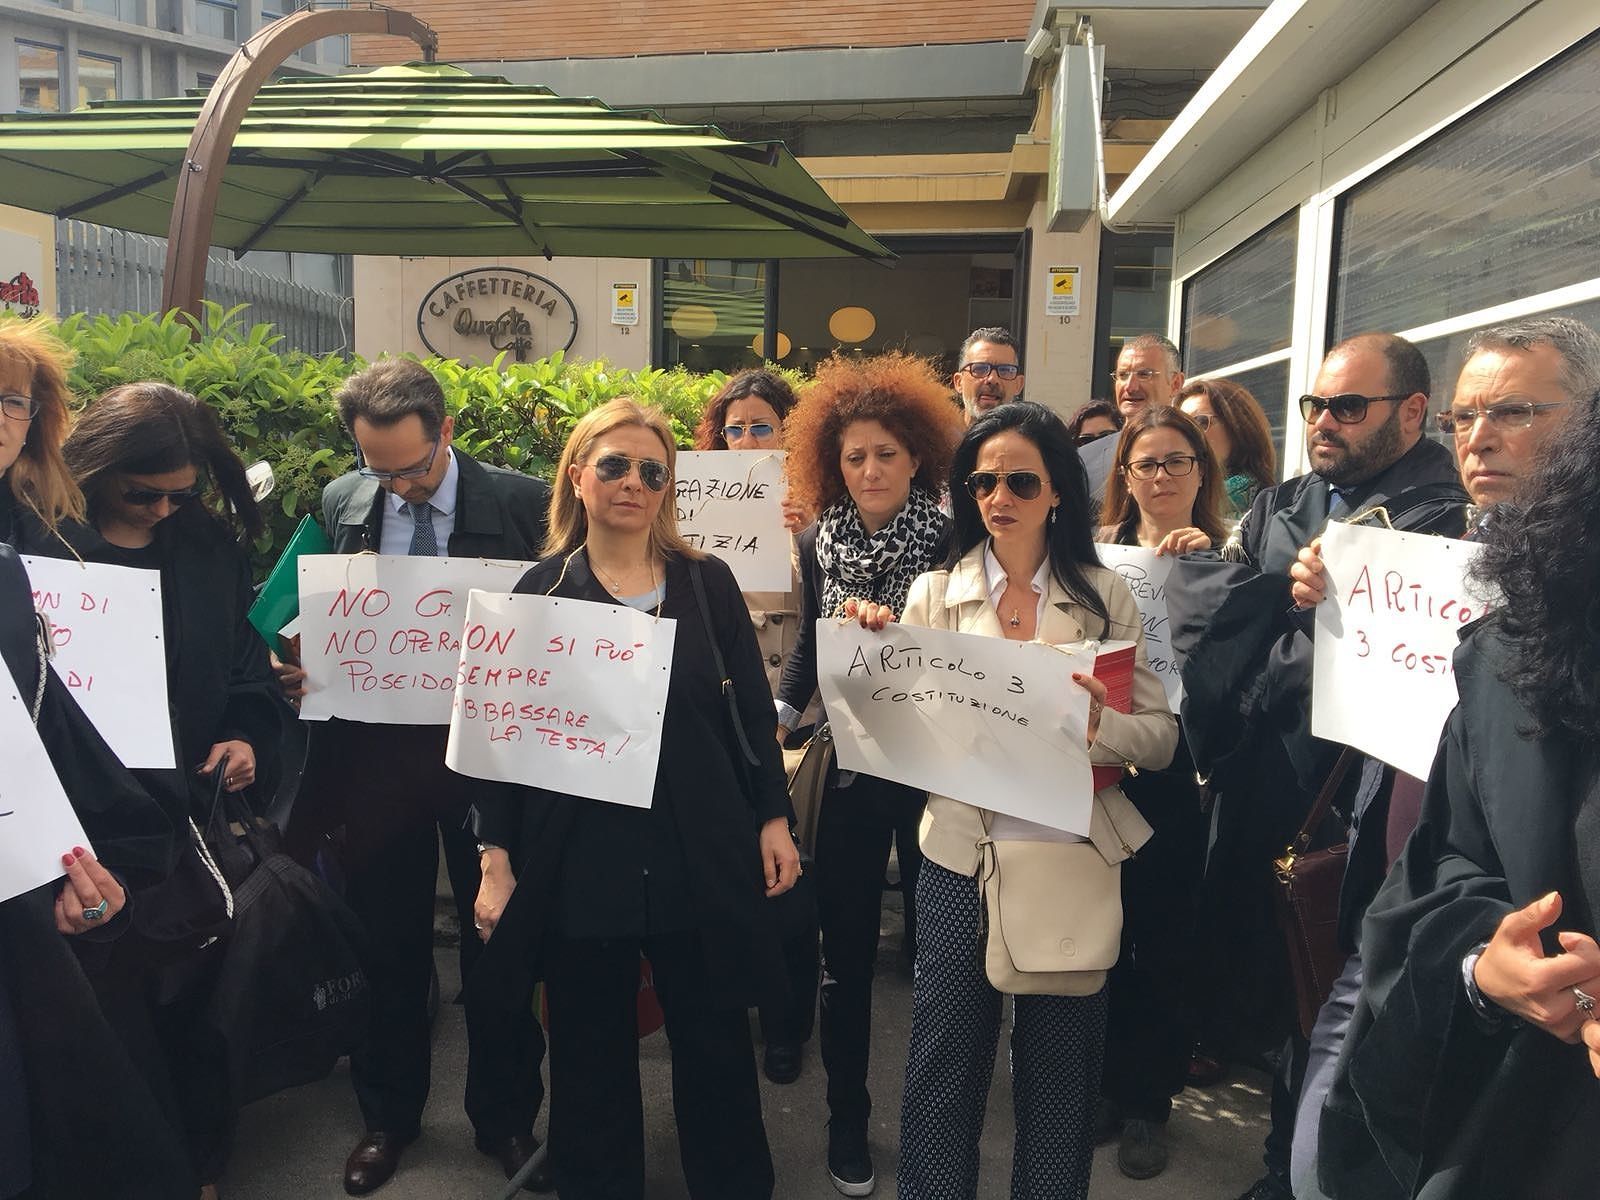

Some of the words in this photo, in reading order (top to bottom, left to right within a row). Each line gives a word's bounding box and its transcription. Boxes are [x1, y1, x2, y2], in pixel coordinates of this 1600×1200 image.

[429, 277, 557, 318] CAFFETTERIA
[453, 306, 532, 337] Quarta
[621, 327, 630, 335] 12
[1060, 315, 1071, 325] 10
[80, 592, 109, 614] DI
[328, 588, 390, 617] NO
[324, 629, 377, 656] NO
[389, 629, 462, 655] OPERA
[464, 621, 515, 655] ON
[546, 636, 575, 655] SI
[1357, 630, 1370, 657] 3
[68, 671, 93, 691] DI
[339, 661, 457, 693] POSEIDO
[847, 644, 986, 680] ARTICOLO
[1007, 676, 1025, 694] 3
[454, 699, 590, 728] BBASSARE
[871, 687, 1029, 727] COSTITUZIONE
[490, 725, 522, 742] LA
